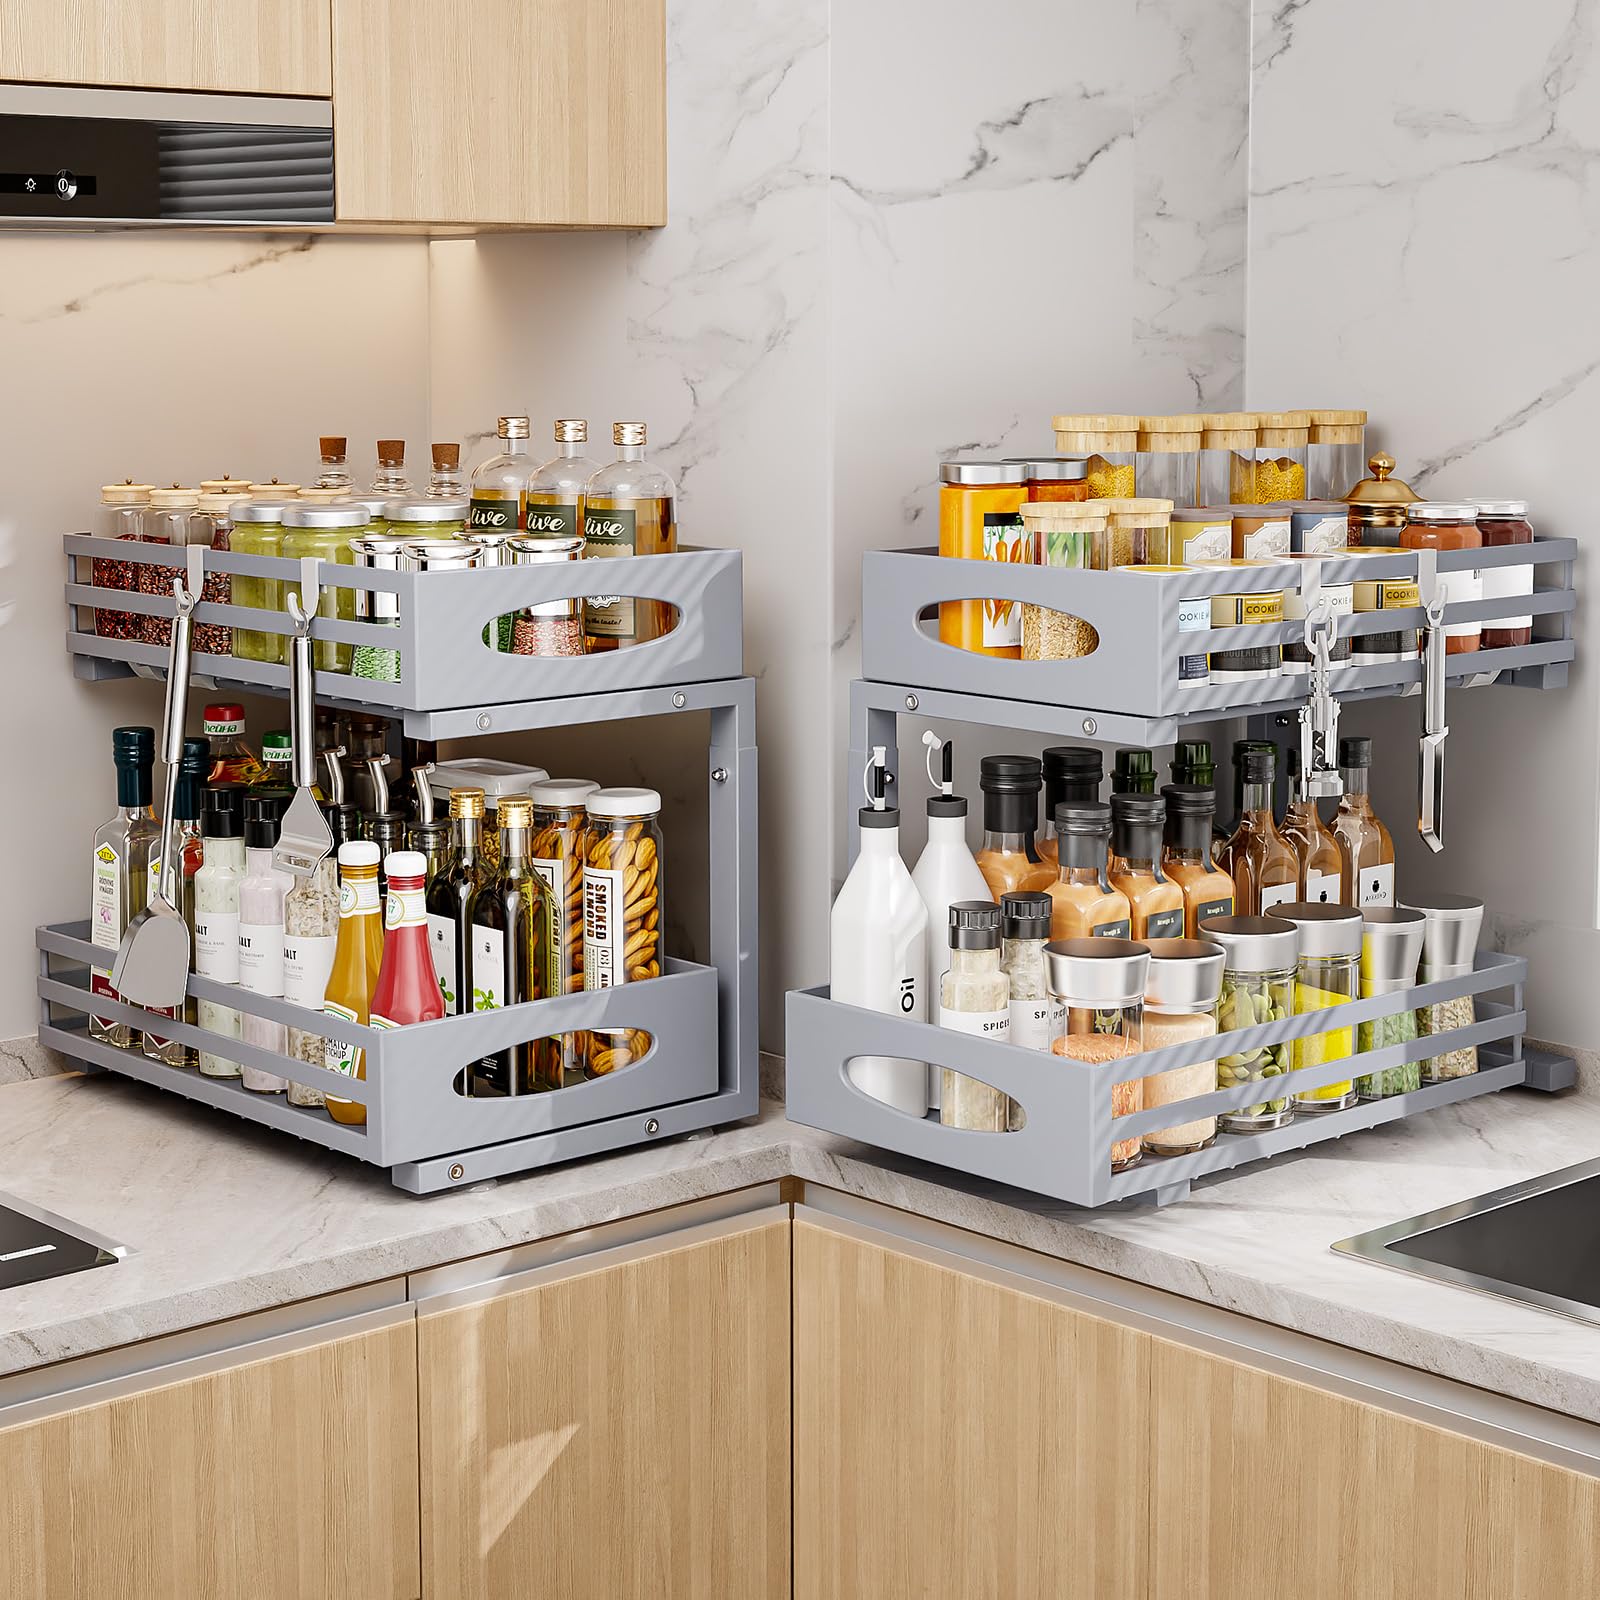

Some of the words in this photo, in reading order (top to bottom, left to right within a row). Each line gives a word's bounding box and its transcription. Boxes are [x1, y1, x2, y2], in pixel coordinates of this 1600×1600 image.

[470, 507, 508, 526] live
[527, 512, 566, 531] live
[584, 517, 625, 537] live
[1386, 589, 1415, 599] COOKIE
[1178, 611, 1205, 622] OOKIE
[1246, 603, 1278, 615] COOKIE
[586, 881, 595, 939] ALMOND
[595, 883, 607, 941] SMOKED
[599, 949, 610, 966] 03
[900, 977, 915, 1013] Oil
[326, 1047, 347, 1060] ETCHUP
